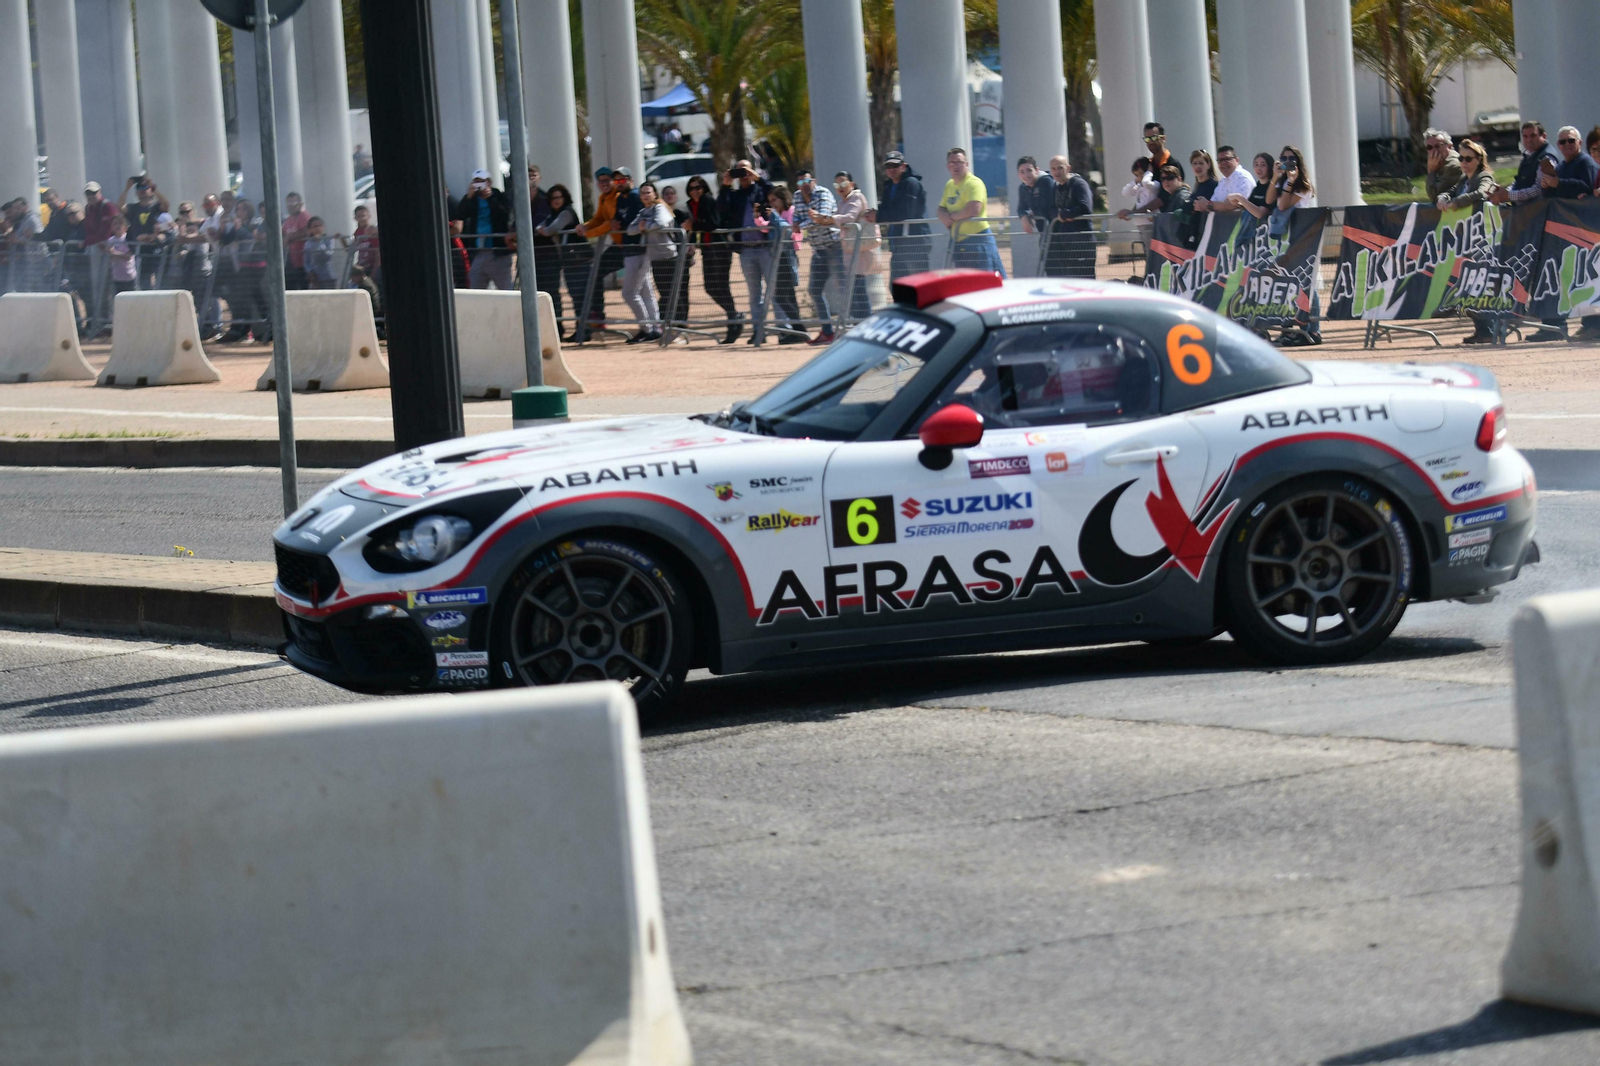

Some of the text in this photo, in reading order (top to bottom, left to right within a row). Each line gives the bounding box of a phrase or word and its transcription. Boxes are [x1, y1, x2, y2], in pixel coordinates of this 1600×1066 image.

[1239, 274, 1298, 311] JABER
[1454, 266, 1513, 304] JABER
[1165, 323, 1214, 386] 6
[1240, 403, 1390, 432] ABARTH
[538, 458, 700, 492] ABARTH
[982, 458, 1029, 472] IMDECO
[749, 476, 788, 488] SMC
[924, 491, 1033, 517] SUZUKI
[748, 511, 821, 529] Rallycar
[846, 497, 880, 546] 6
[1463, 510, 1504, 525] MICHELIN
[584, 540, 651, 566] MICHELIN
[1458, 543, 1490, 560] PAGID
[428, 592, 480, 603] MICHELIN
[755, 544, 1081, 627] AFRASA
[449, 667, 489, 680] PAGID
